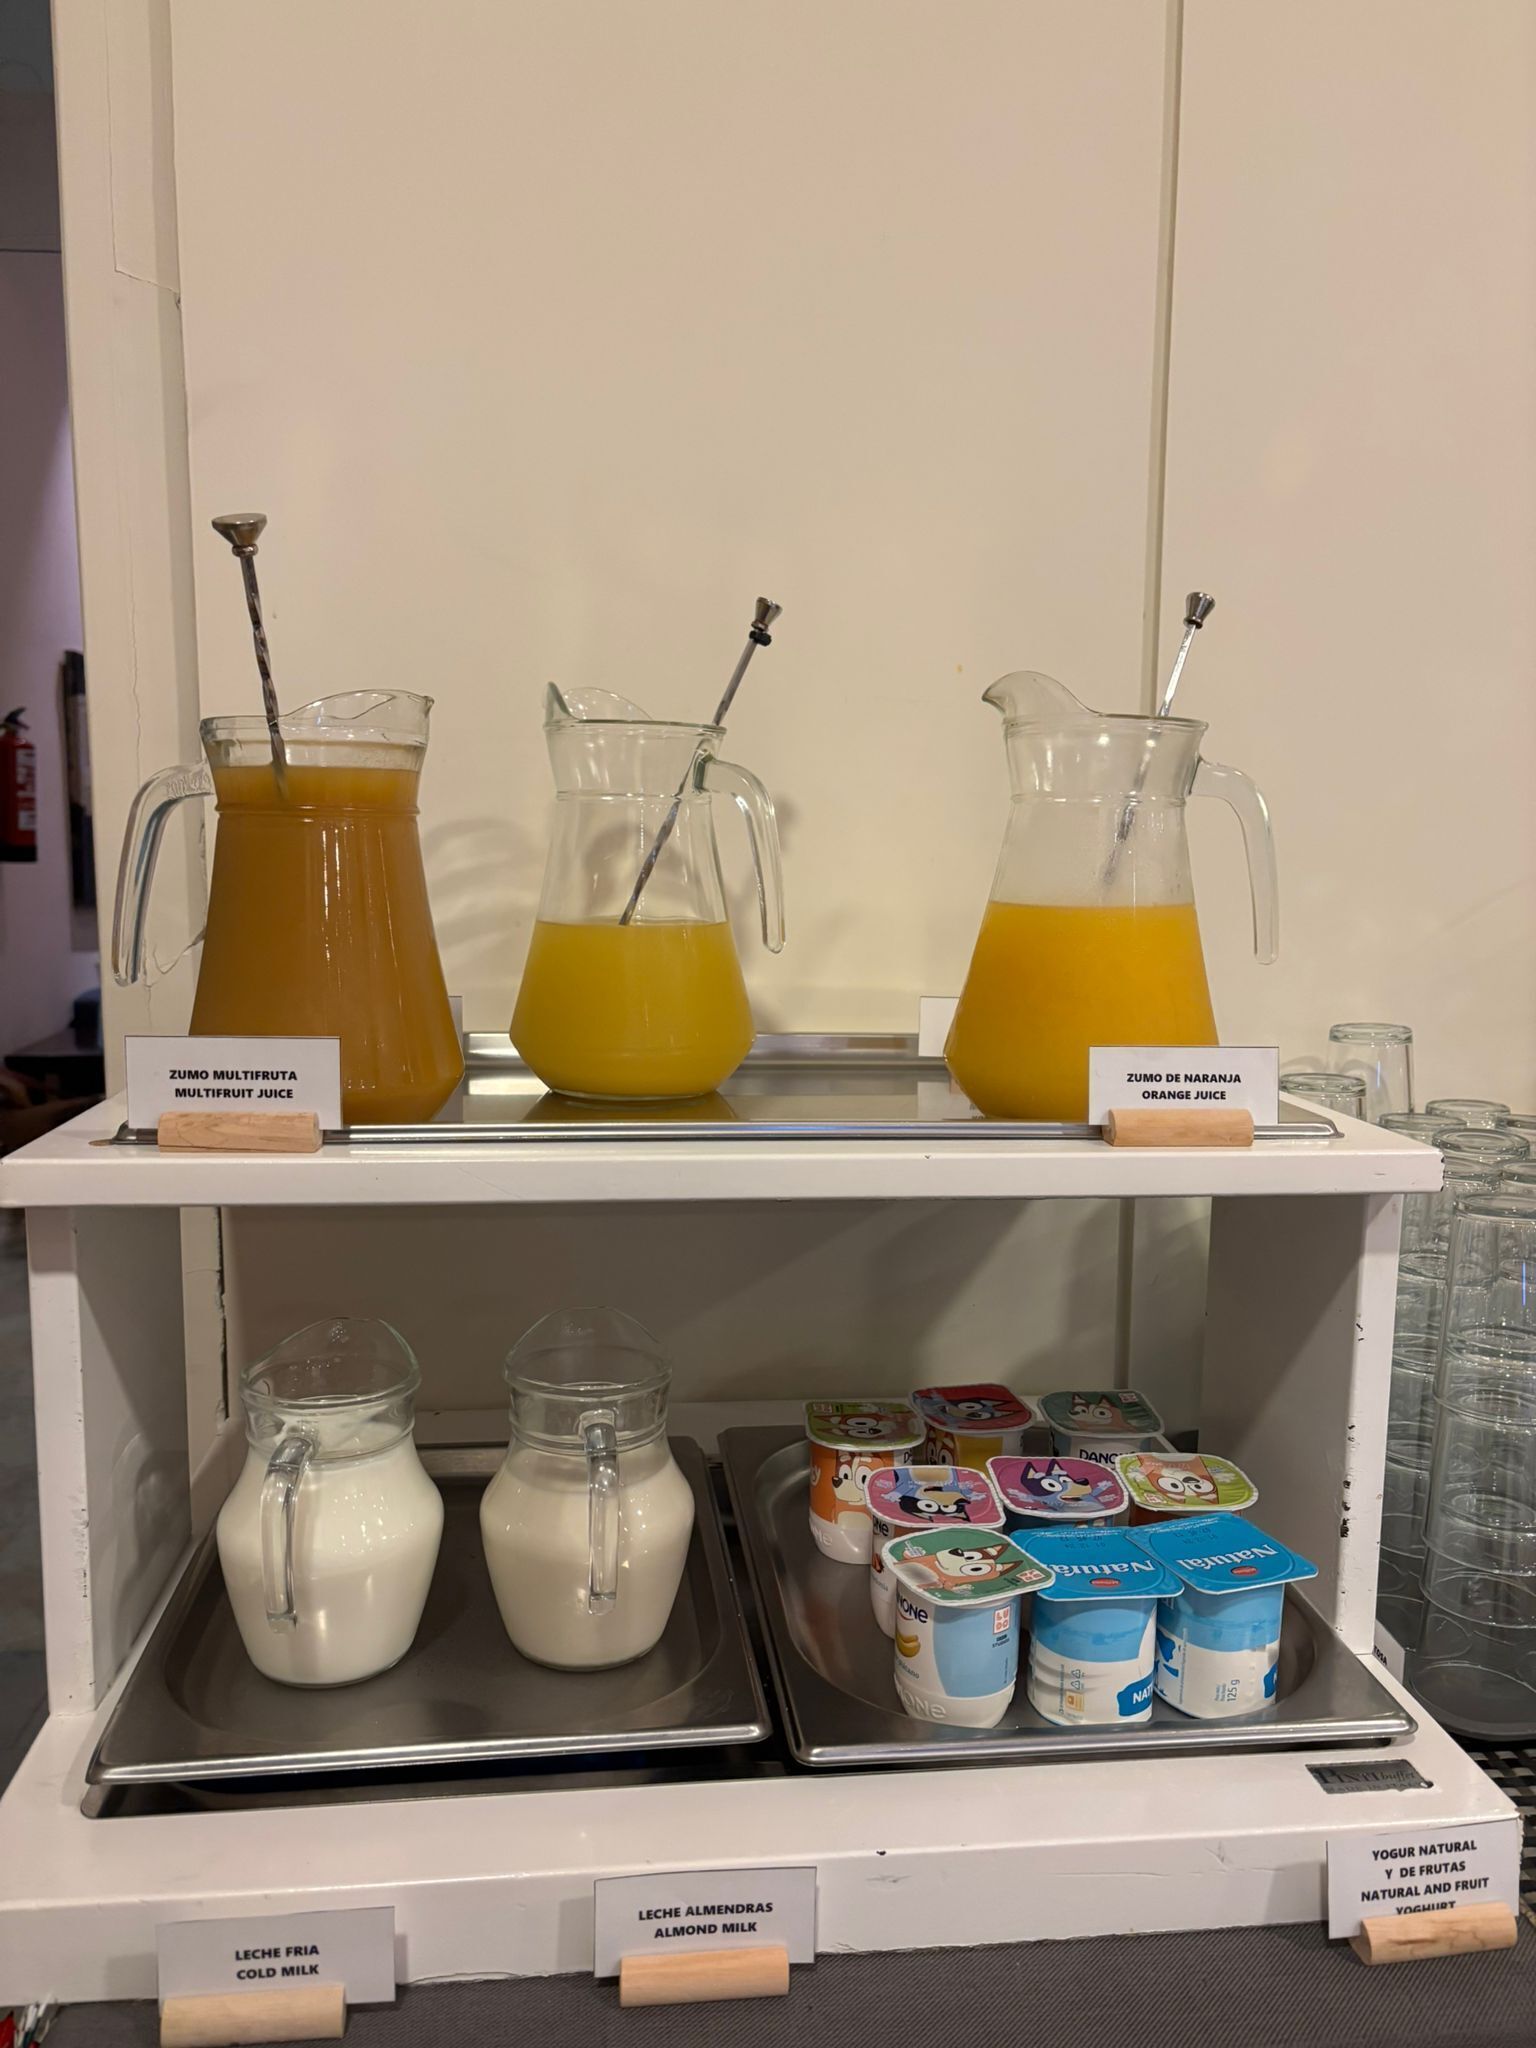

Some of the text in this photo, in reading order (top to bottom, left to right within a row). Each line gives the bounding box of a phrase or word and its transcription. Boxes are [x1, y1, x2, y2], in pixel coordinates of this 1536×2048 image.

[169, 1069, 298, 1081] ZUMO MULTIFRUTA
[1126, 1073, 1242, 1084] ZUMO DE NARANJA
[174, 1087, 294, 1099] MULTIFRUIT JUICE
[1141, 1090, 1227, 1100] ORANGE JUICE
[1176, 1544, 1278, 1570] Natural
[1047, 1560, 1155, 1576] Natura
[1227, 1686, 1237, 1702] 125
[1372, 1840, 1477, 1861] YOGUR NATURAL
[1385, 1860, 1466, 1880] Y DE FRUTAS
[1361, 1877, 1489, 1902] NATURAL AND FRUIT
[638, 1902, 773, 1921] LECHE ALMENDRAS
[654, 1921, 757, 1939] ALMOND MILK
[235, 1944, 320, 1961] LECHE FRIA
[236, 1964, 319, 1980] COLD MILK
